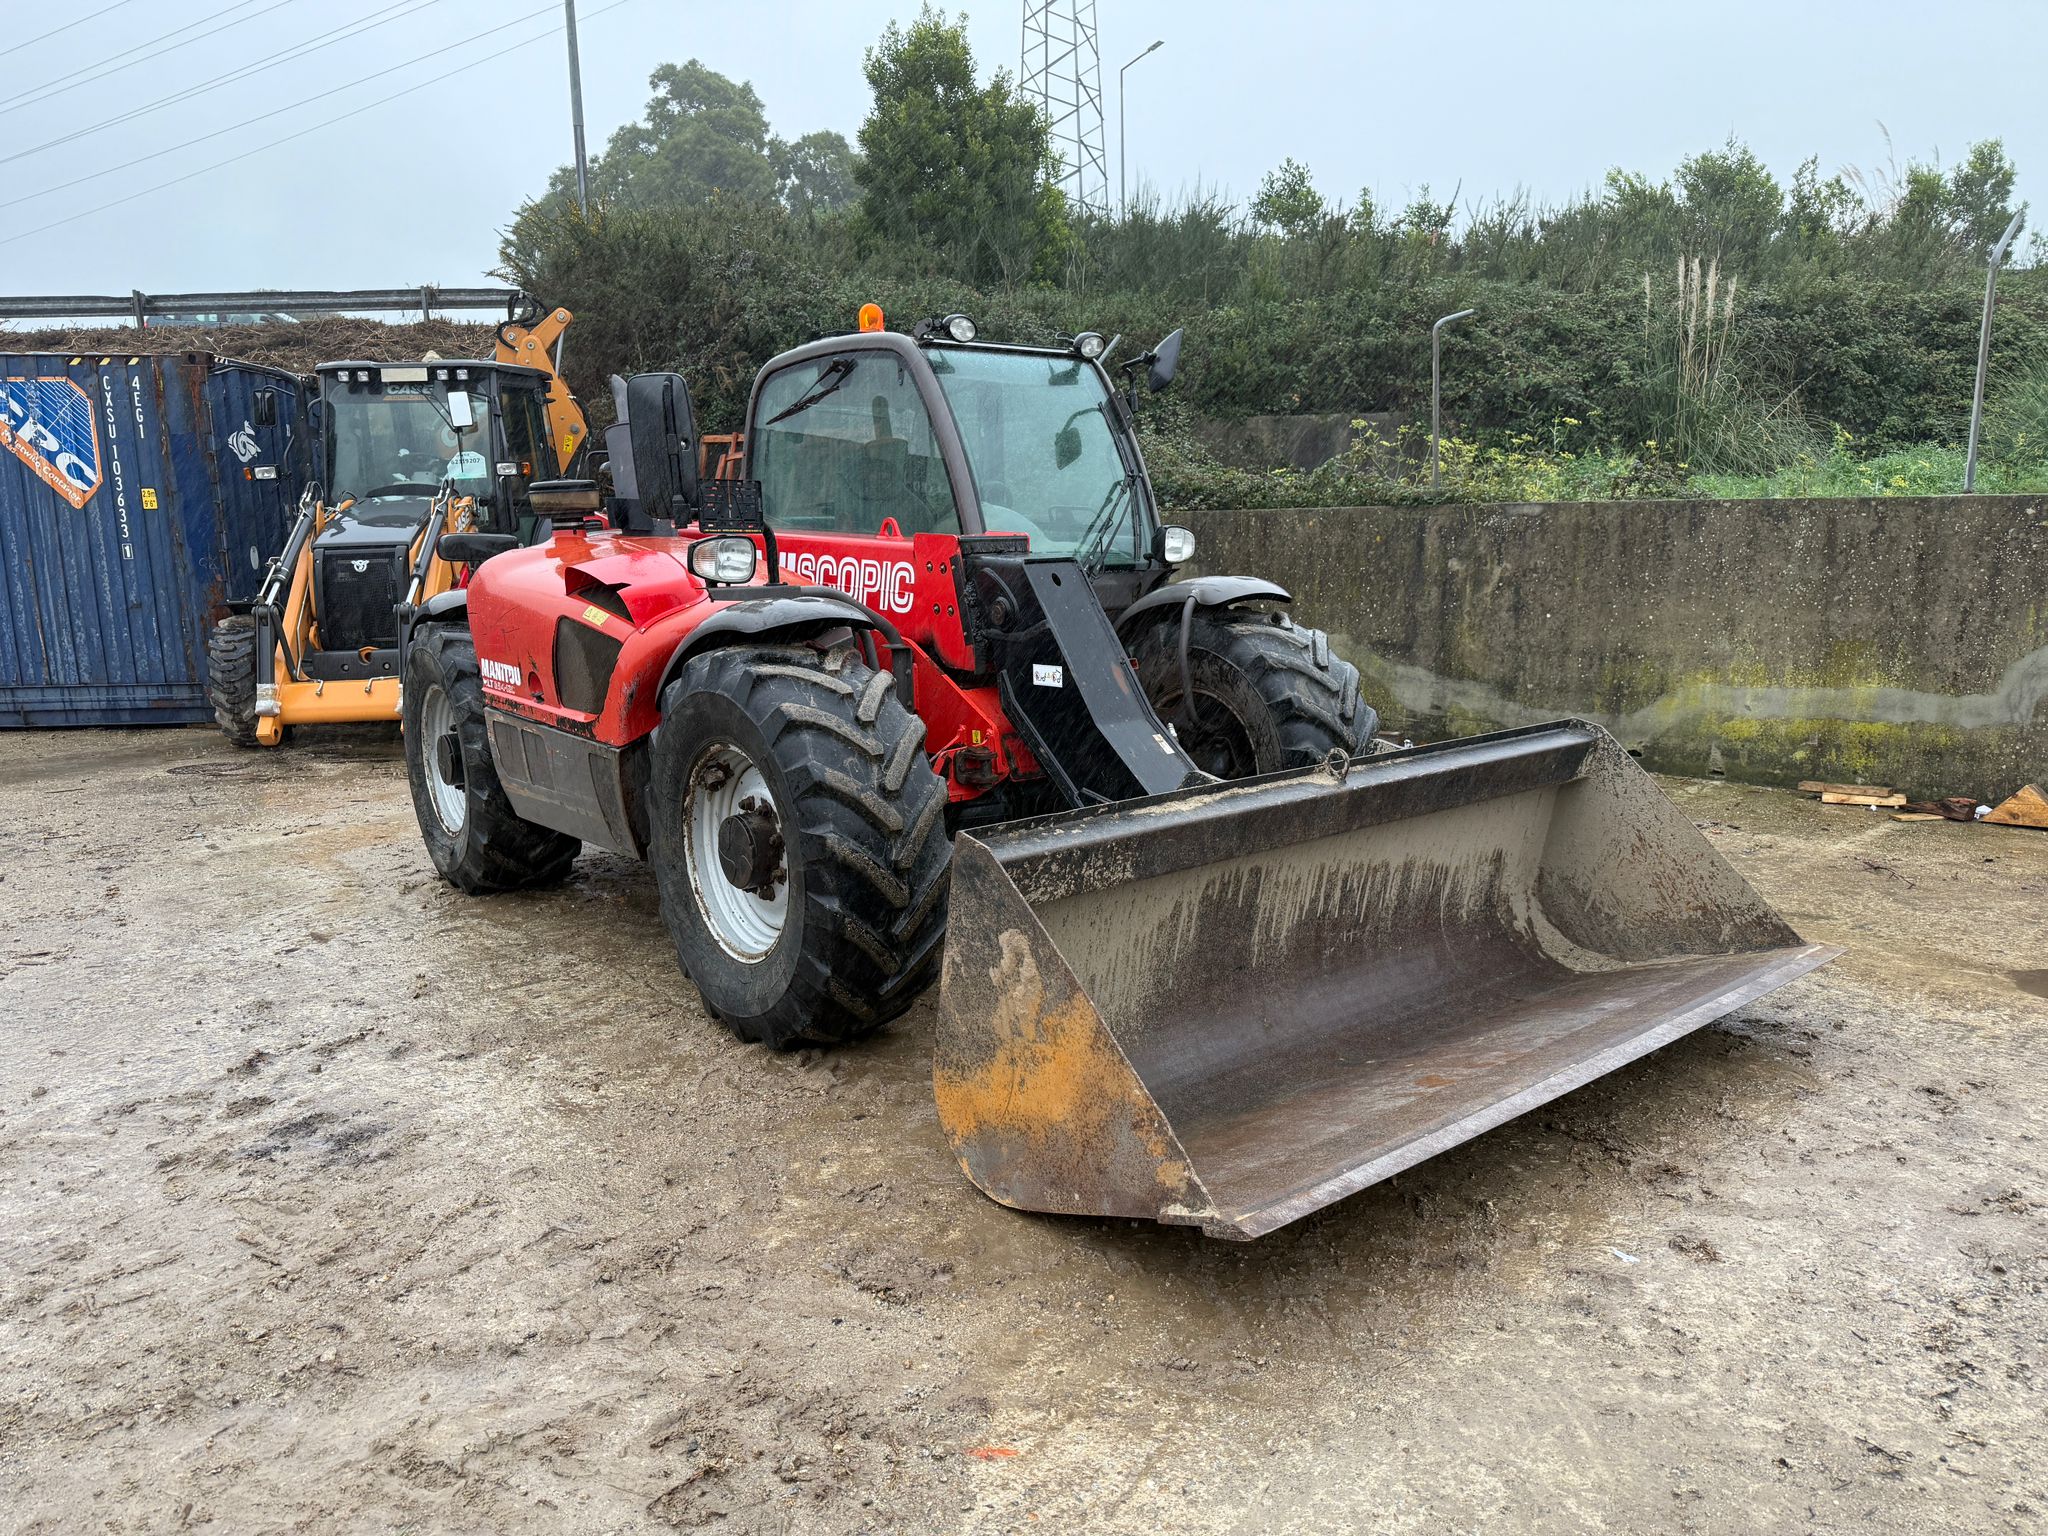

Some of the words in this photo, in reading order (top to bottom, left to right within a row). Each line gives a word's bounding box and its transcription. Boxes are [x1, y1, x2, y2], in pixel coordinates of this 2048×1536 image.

[132, 376, 145, 438] 4EG1
[103, 376, 116, 438] CXSU
[112, 445, 129, 538] 103633
[481, 658, 522, 686] MANITOU
